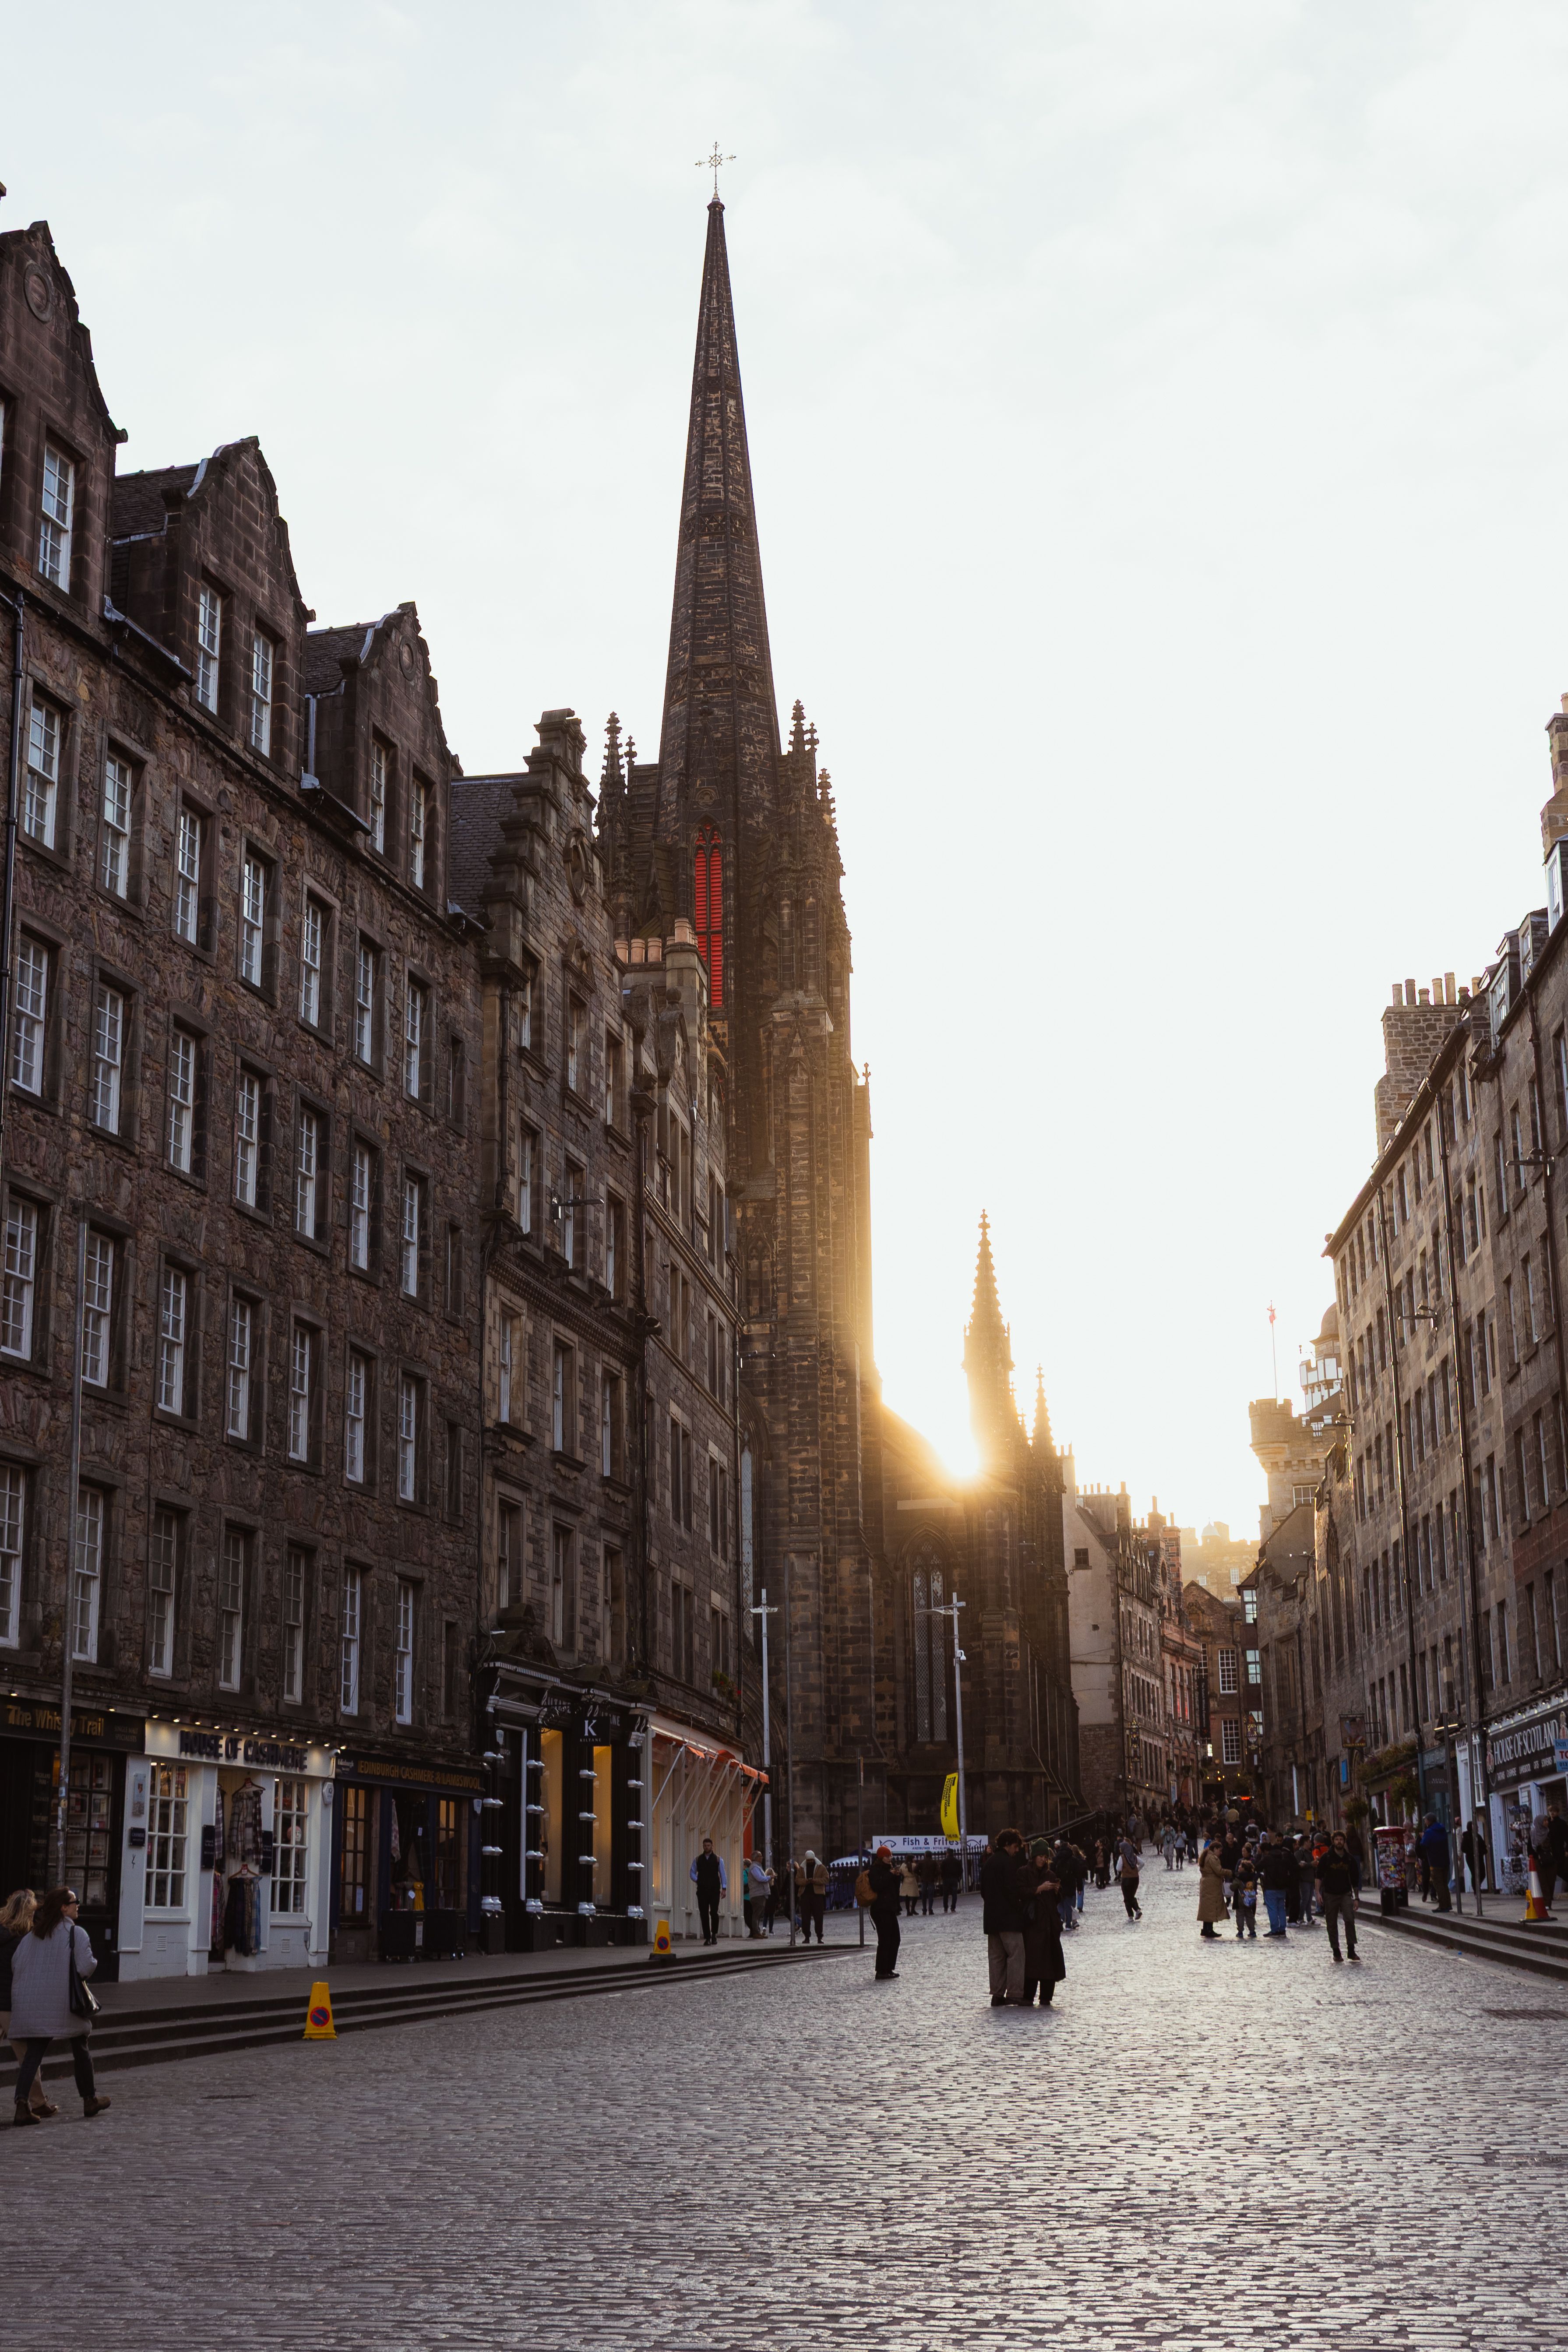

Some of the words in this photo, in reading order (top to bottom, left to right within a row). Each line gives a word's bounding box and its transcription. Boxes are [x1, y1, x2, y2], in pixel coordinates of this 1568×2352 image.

[7, 1705, 32, 1727] The
[35, 1708, 77, 1737] Whisy
[78, 1715, 105, 1737] Trail
[584, 1720, 597, 1736] K
[180, 1730, 223, 1758] HOUSE
[226, 1737, 242, 1760] OF
[244, 1740, 308, 1769] CASHMERE
[1494, 1736, 1514, 1765] HOUSE
[1514, 1732, 1522, 1758] OF
[1523, 1720, 1559, 1755] SCOTLAND
[358, 1760, 399, 1778] EDINBURGH
[401, 1767, 434, 1783] CASHMERE
[435, 1772, 441, 1784] &
[442, 1773, 481, 1789] LAMBSWOOL
[903, 1837, 920, 1846] Fish
